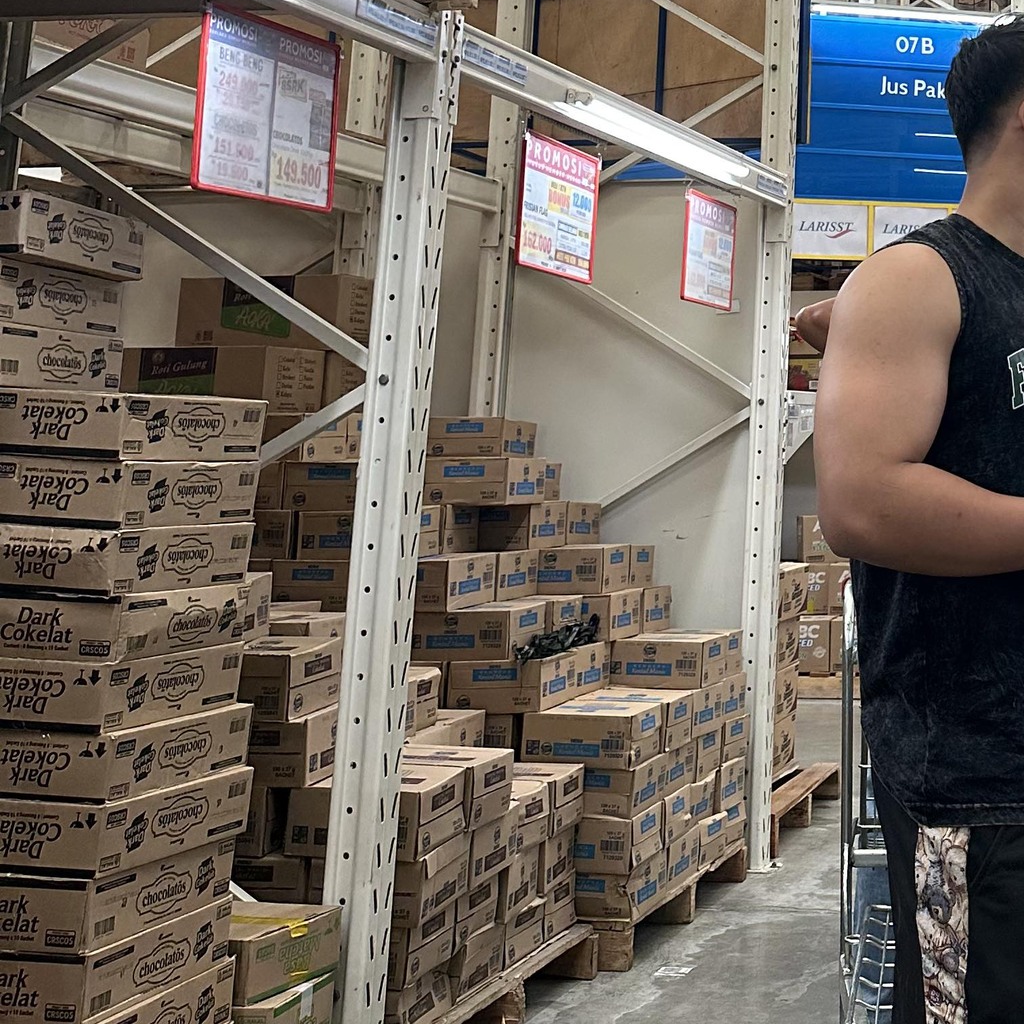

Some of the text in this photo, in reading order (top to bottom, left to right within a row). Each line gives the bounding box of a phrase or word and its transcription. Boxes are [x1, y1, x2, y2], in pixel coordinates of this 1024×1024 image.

[210, 14, 257, 42] PROMOSI
[279, 38, 323, 64] PROMOSI
[880, 76, 908, 96] Jus
[527, 139, 582, 175] PROMOSI
[799, 221, 855, 232] LARISST
[883, 224, 919, 235] LARIS
[151, 359, 208, 375] Roti Gulung
[22, 405, 88, 425] Cokelat
[30, 422, 72, 441] Dark
[20, 474, 89, 495] Cokelat
[29, 492, 71, 512] Dark
[3, 542, 73, 564] Cokelat
[14, 561, 56, 579] Dark
[16, 606, 64, 627] Dark
[1, 623, 73, 644] Cokelat
[800, 625, 820, 638] BC
[0, 676, 66, 698] Cokela
[3, 694, 47, 715] Dark
[1, 748, 71, 770] Cokelat
[10, 767, 53, 787] Dark
[0, 819, 62, 842] Cokela
[0, 838, 45, 859] Dark
[0, 895, 29, 915] ark
[0, 914, 39, 934] elat
[0, 969, 29, 988] ark
[0, 988, 39, 1007] elat
